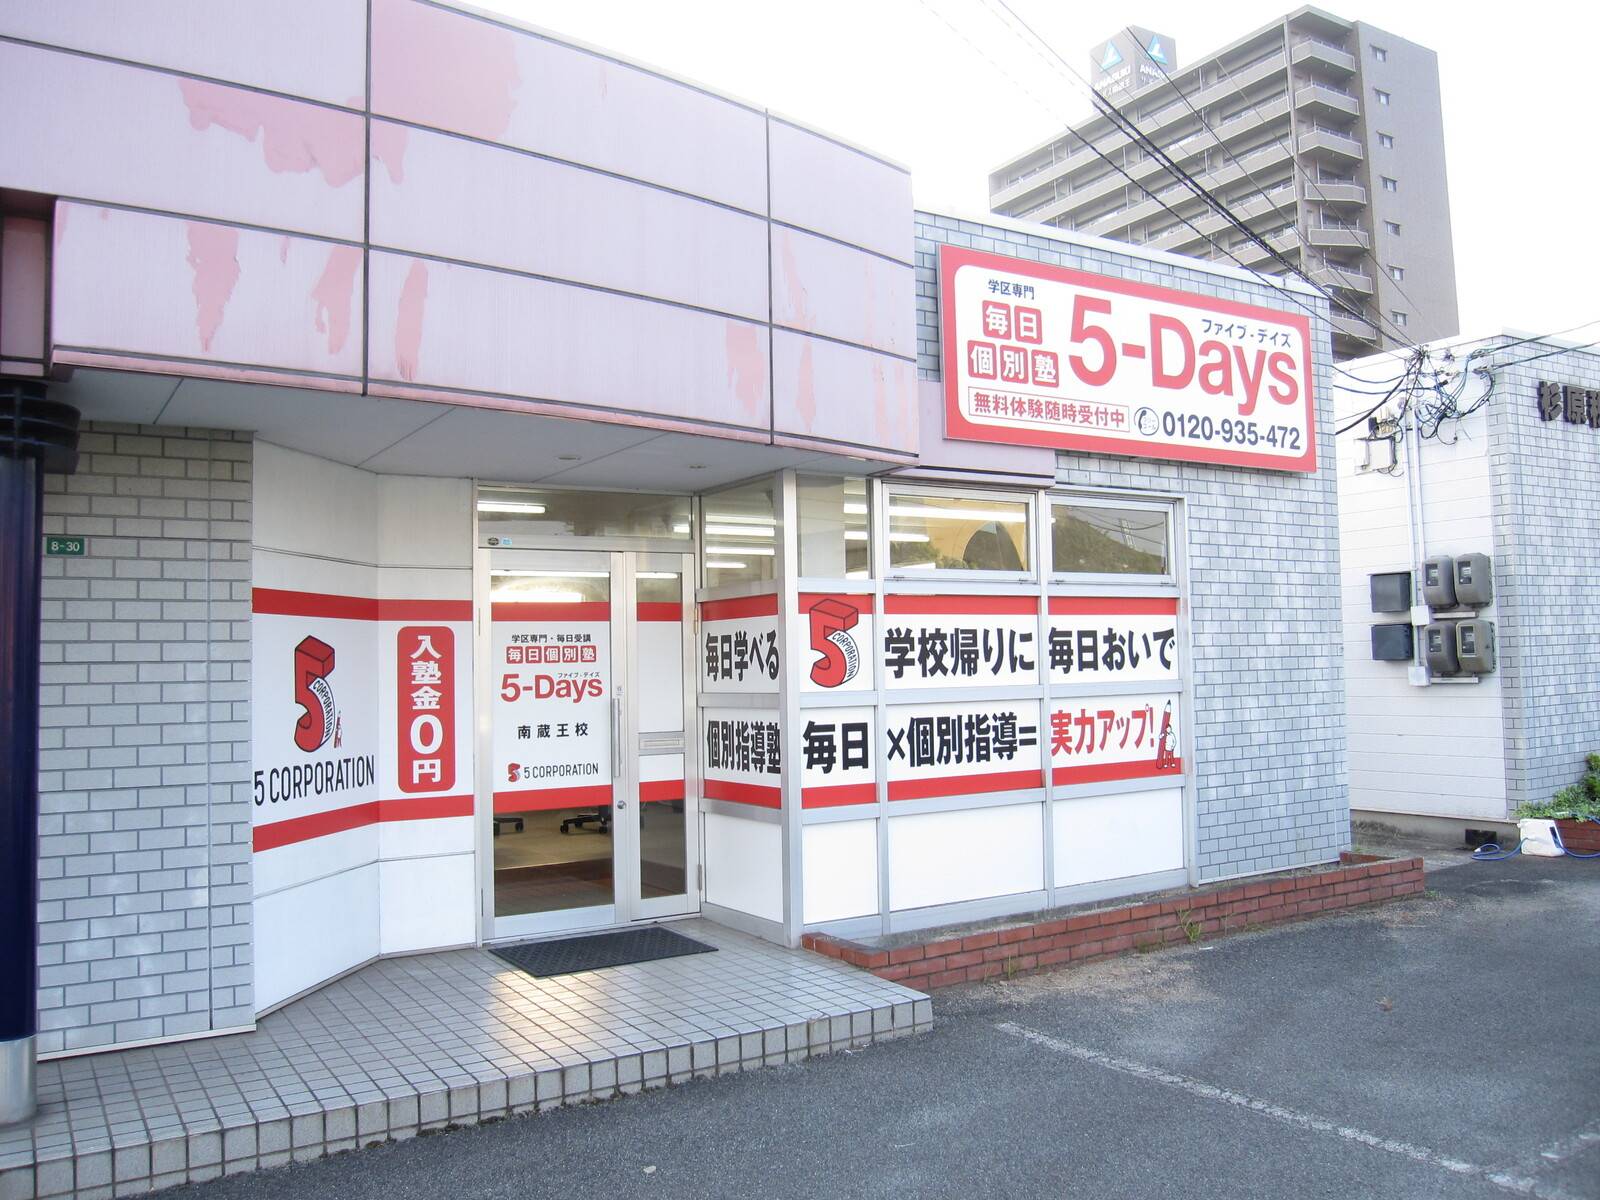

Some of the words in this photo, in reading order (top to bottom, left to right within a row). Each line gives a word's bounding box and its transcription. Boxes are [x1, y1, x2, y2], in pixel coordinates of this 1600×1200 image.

[988, 279, 1035, 300] 学区専門
[984, 303, 1039, 341] 毎日
[1202, 318, 1292, 348] ファイブ・デイズ
[969, 343, 1058, 385] 個別塾
[1069, 294, 1299, 416] 5-Days
[974, 391, 1125, 428] 無料体験随時受付中
[1163, 411, 1300, 450] 0120-935-472
[51, 541, 80, 552] 8-30
[508, 646, 595, 662] 毎日個別塾
[511, 633, 592, 644] 学区専門・毎日受講
[706, 629, 779, 682] 毎日学べる
[832, 632, 858, 678] CORPORATION
[885, 627, 1035, 678] 学校帰りに
[1048, 627, 1175, 676] 毎日おいで
[501, 673, 603, 703] 5-Days
[312, 680, 334, 738] CORPORATION
[517, 722, 588, 740] 南蔵王校
[707, 719, 781, 774] 個別指導塾
[803, 720, 869, 774] 毎日
[254, 770, 265, 806] 5
[269, 755, 375, 803] CORPORATION
[523, 766, 531, 779] 5
[532, 763, 599, 778] CORPORATION
